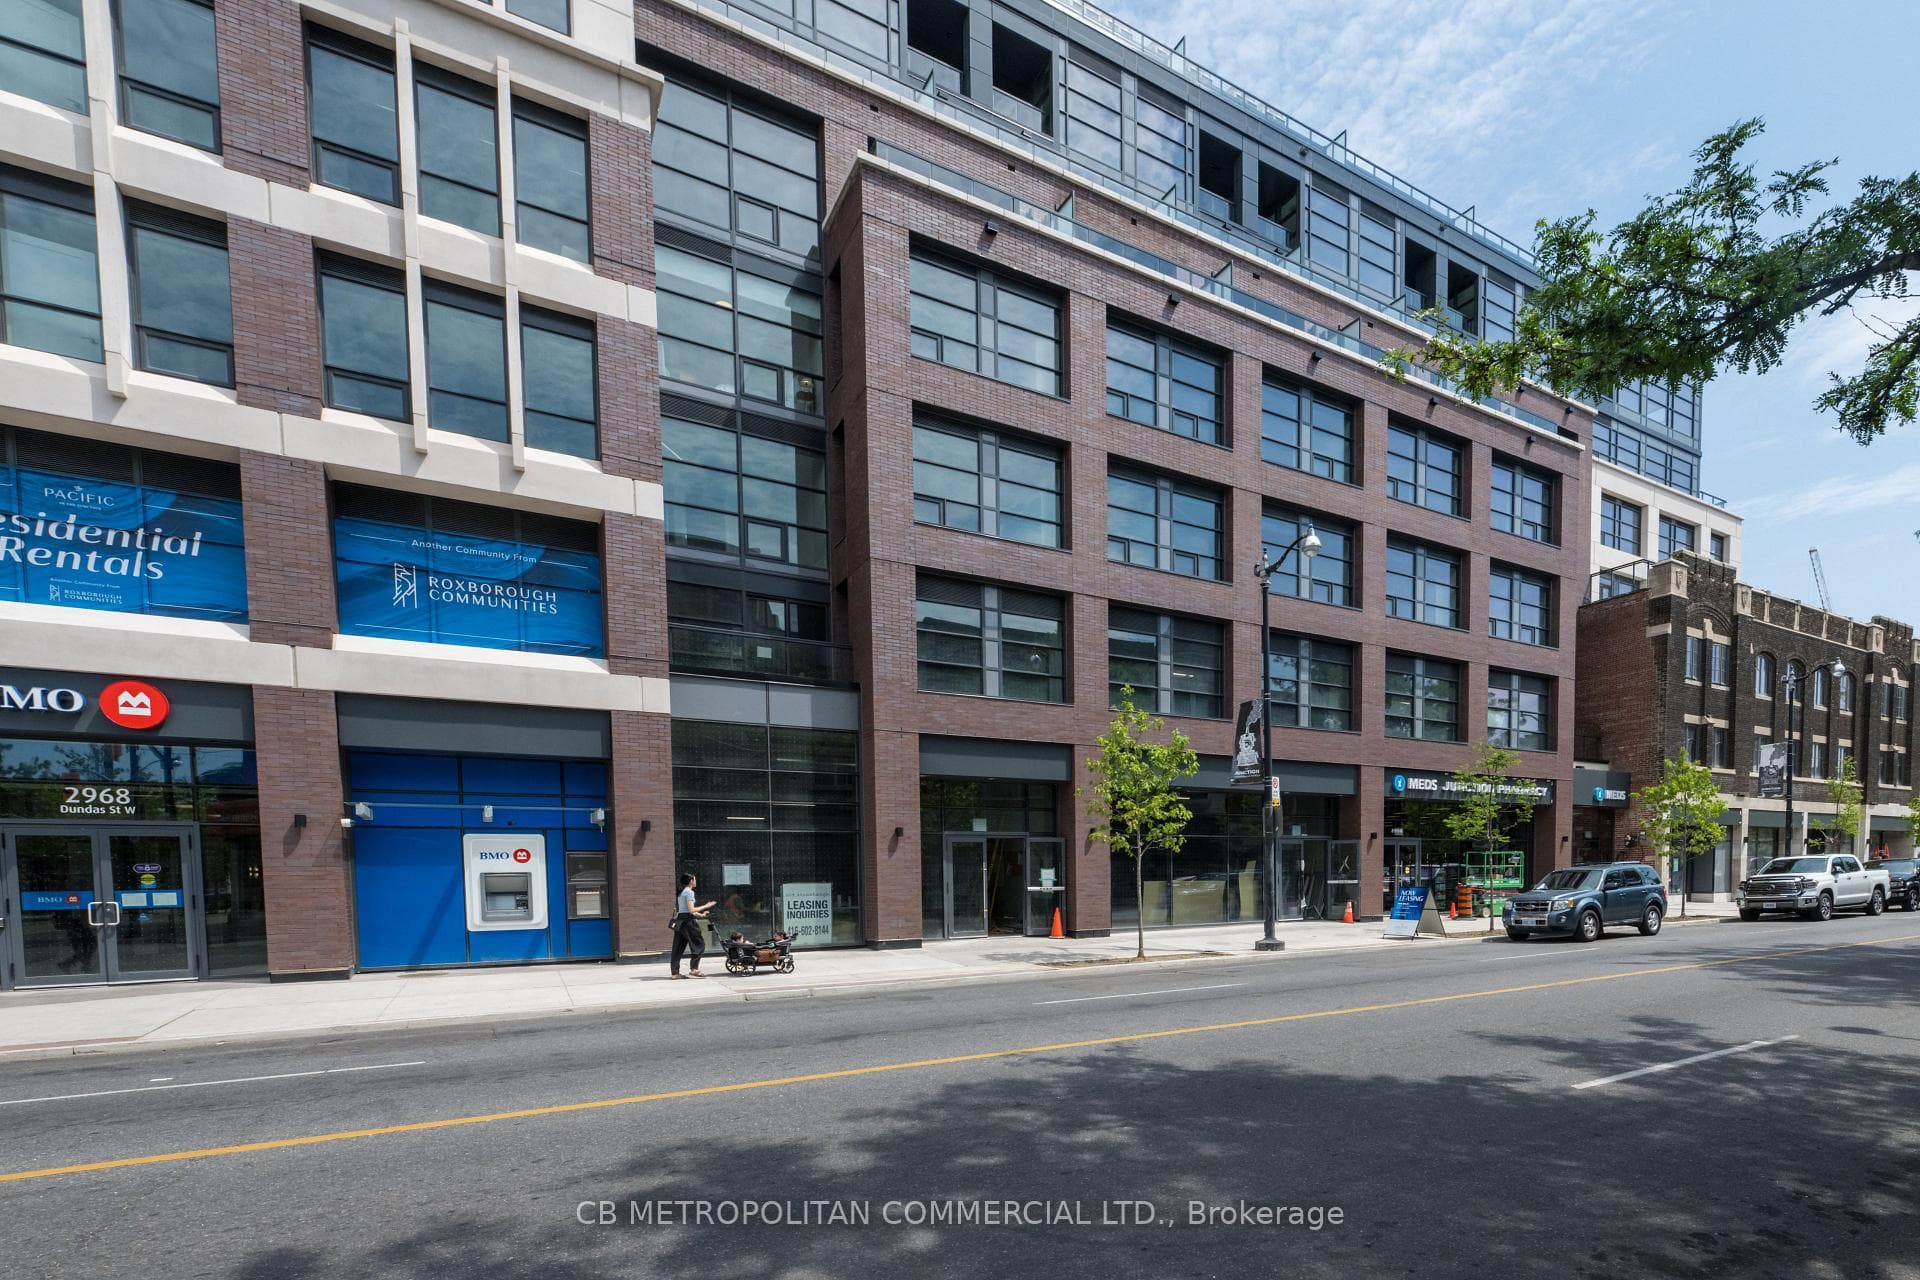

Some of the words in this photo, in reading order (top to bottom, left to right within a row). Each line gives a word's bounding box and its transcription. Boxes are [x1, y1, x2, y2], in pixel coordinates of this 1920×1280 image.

[44, 487, 115, 506] PACIFIC
[0, 511, 202, 556] sidential
[411, 539, 451, 551] Another
[455, 545, 511, 560] Community
[513, 553, 537, 563] From
[0, 536, 164, 580] Rentals
[64, 589, 122, 599] ROXBOROUGH
[428, 576, 557, 602] ROXBOROUGH
[64, 594, 123, 604] COMMUNITIES
[428, 589, 557, 614] COMMUNITIES
[1407, 777, 1438, 790] MEDS
[64, 786, 131, 804] 2968
[1605, 789, 1626, 800] MEDS
[60, 804, 106, 814] Dundas
[109, 805, 121, 814] St
[124, 806, 136, 815] W
[480, 852, 510, 860] BMO
[787, 900, 828, 910] LEASING
[786, 910, 829, 919] INQUIRIES
